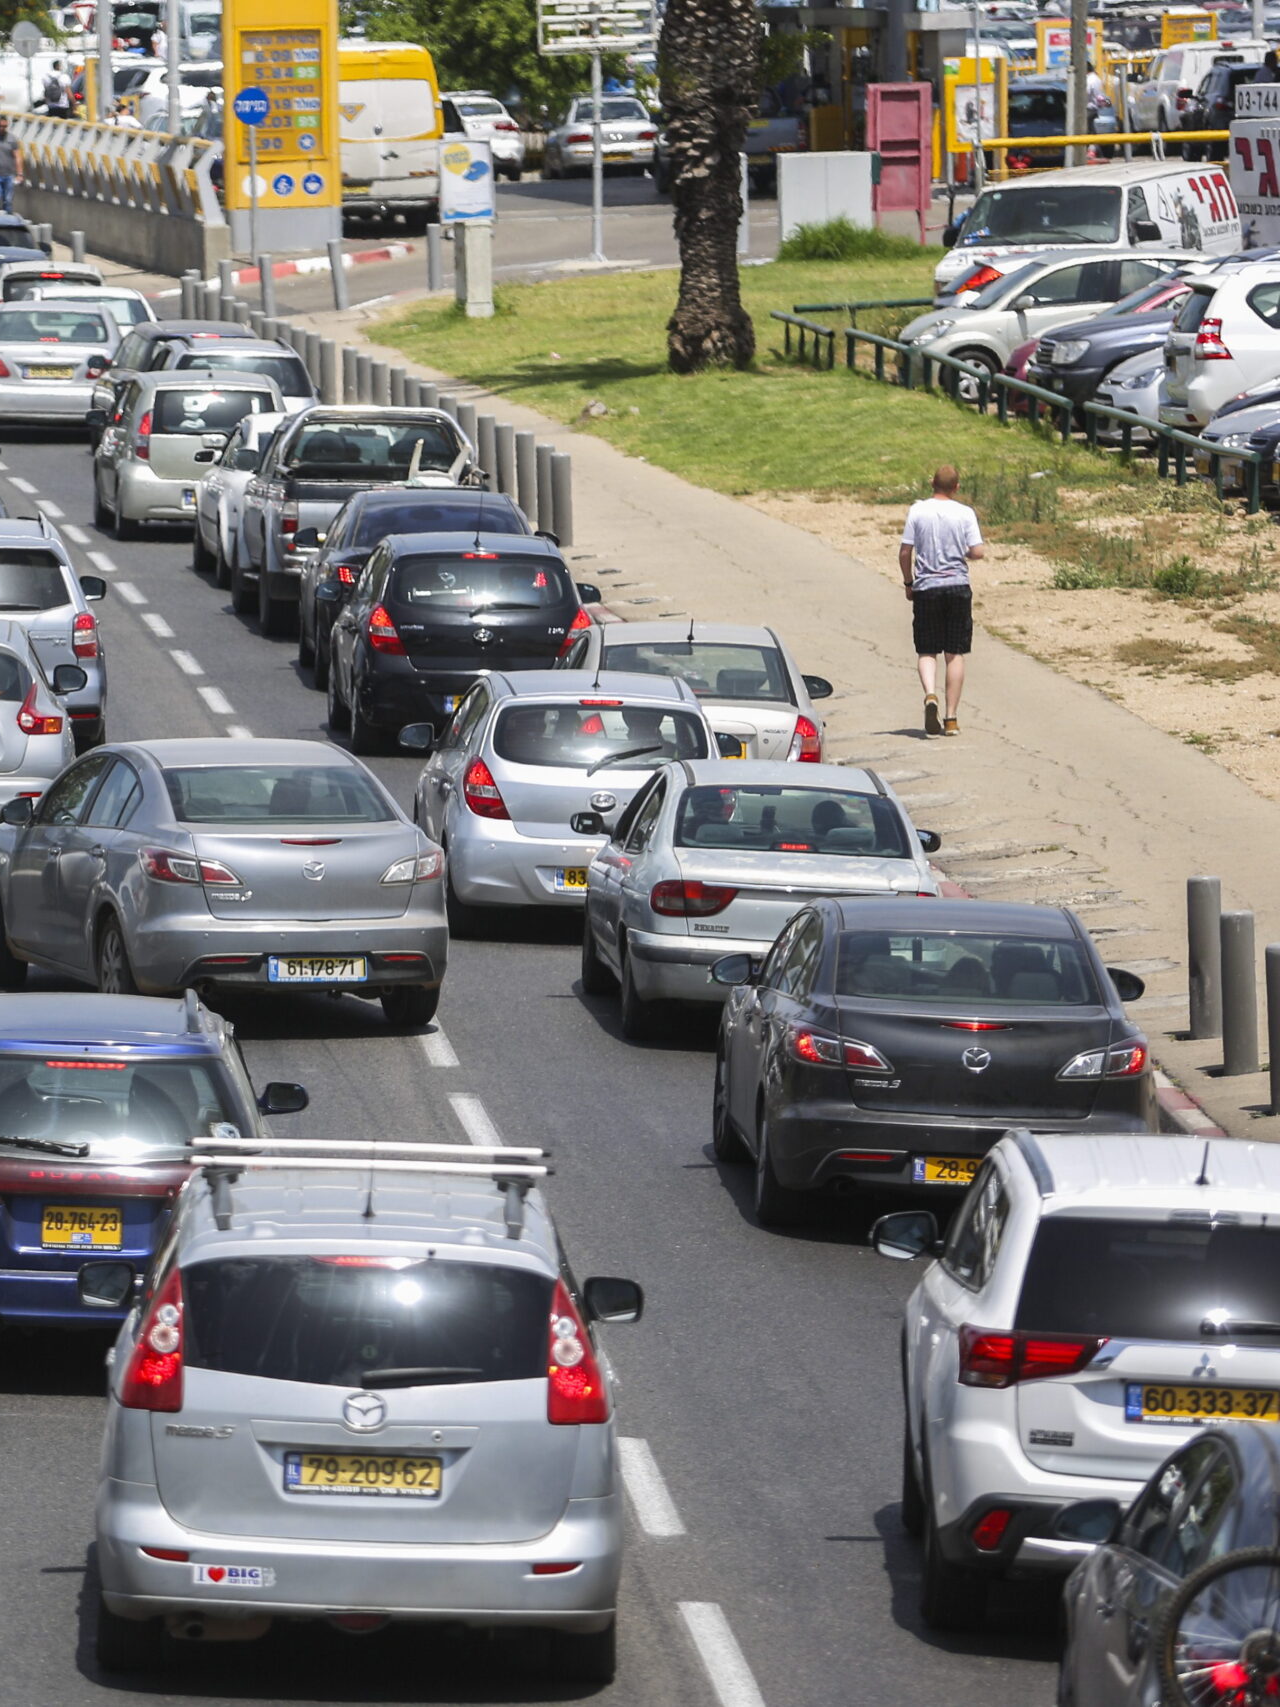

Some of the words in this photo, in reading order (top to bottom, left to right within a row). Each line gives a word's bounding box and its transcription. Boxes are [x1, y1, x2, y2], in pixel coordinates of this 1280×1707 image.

[1188, 173, 1238, 222] חגי
[694, 924, 730, 933] RENAULT
[198, 1566, 206, 1582] I
[227, 1567, 260, 1579] BIG
